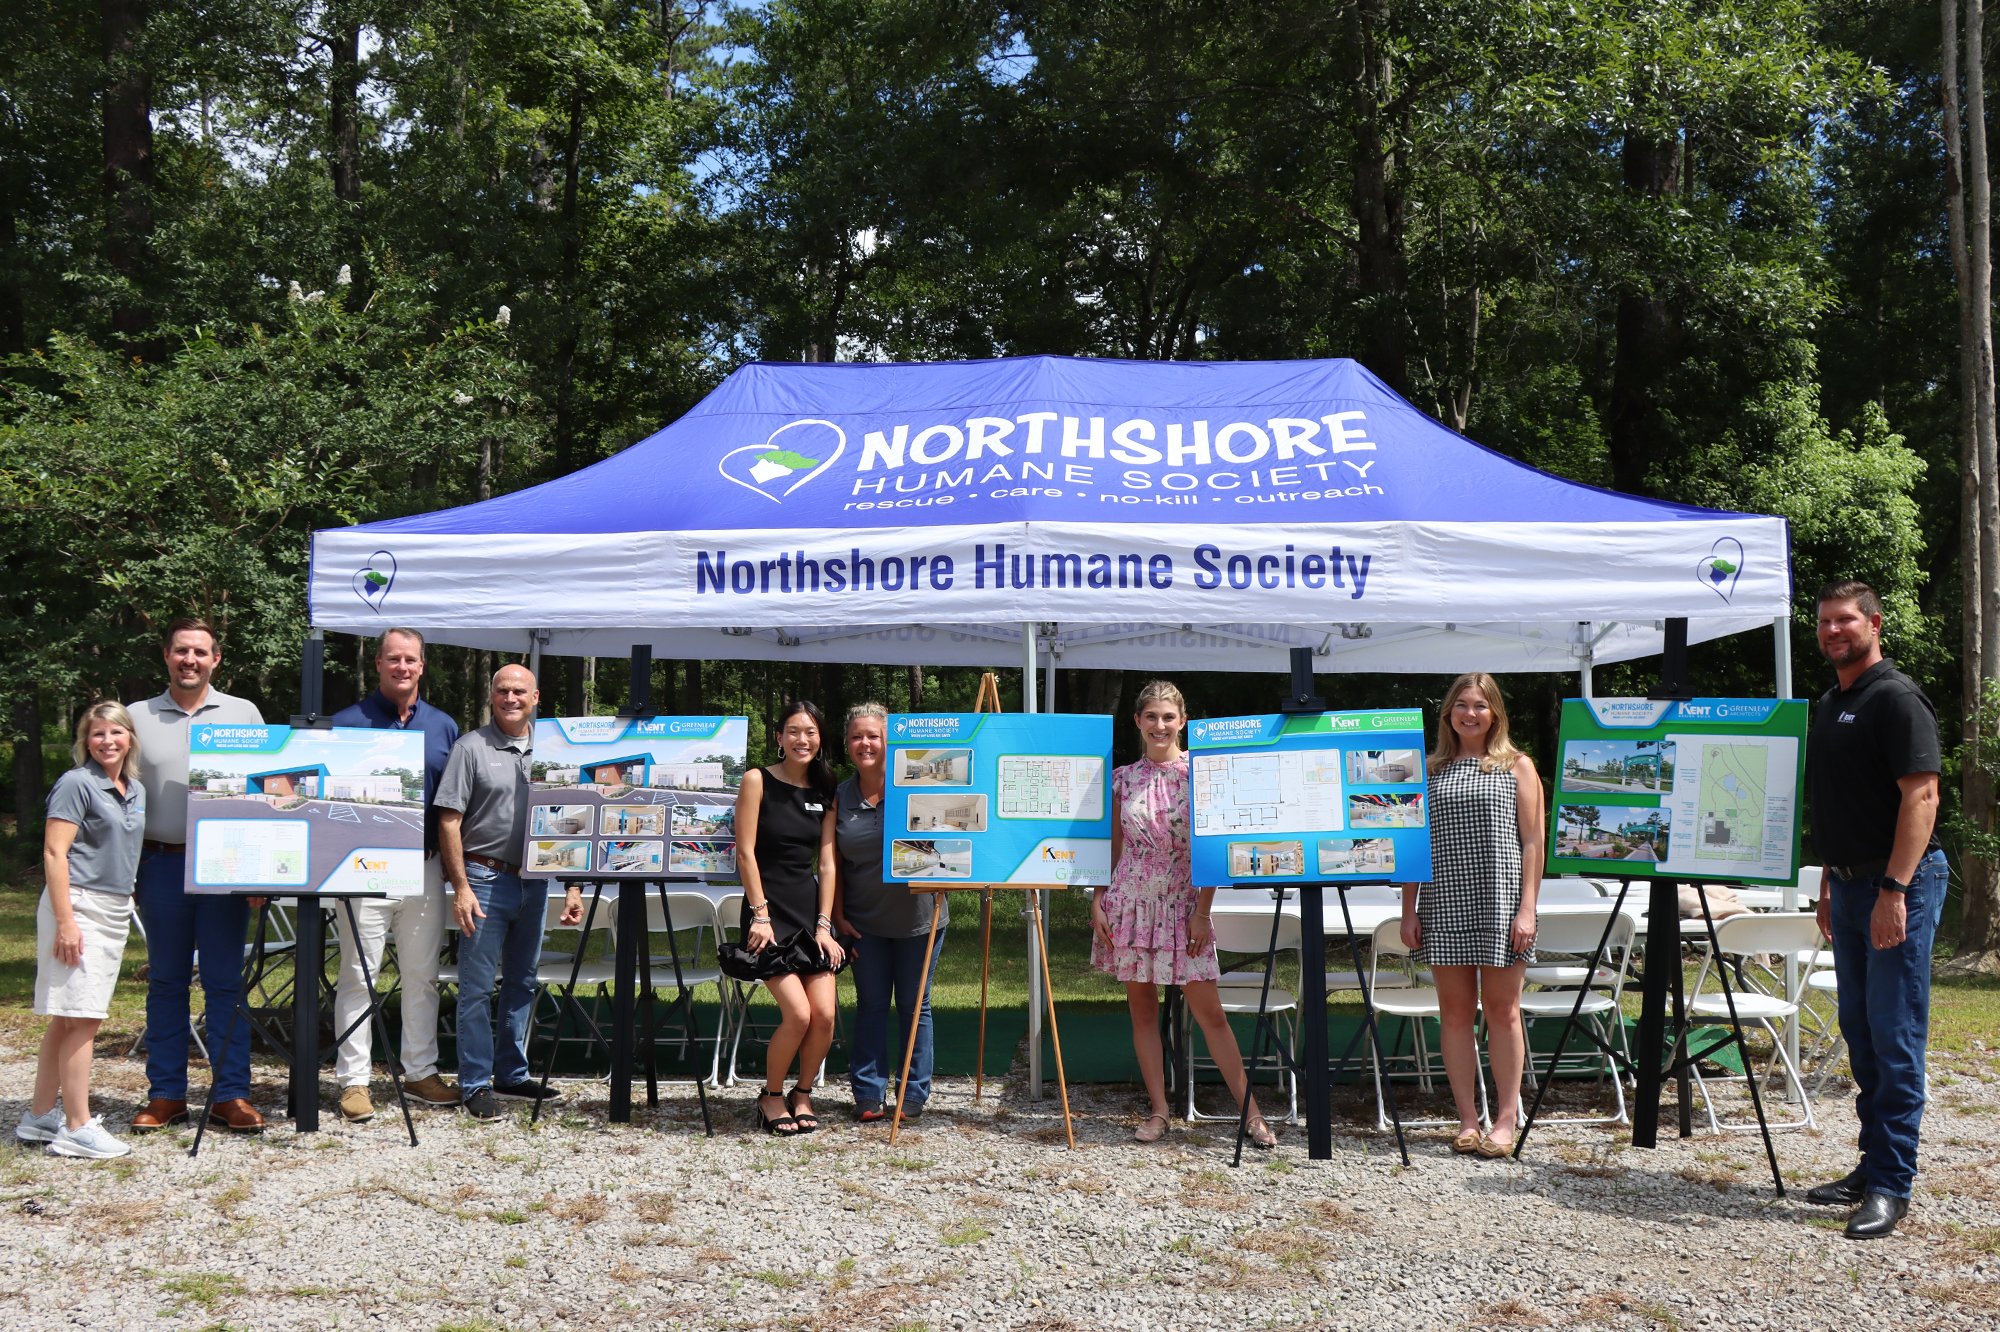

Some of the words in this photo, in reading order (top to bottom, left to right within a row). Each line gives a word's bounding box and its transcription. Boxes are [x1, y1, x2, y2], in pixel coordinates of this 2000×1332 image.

[857, 411, 1377, 471] NORTHSHORE
[852, 461, 1094, 496] HUMANE
[1121, 460, 1376, 491] SOCIETY
[843, 495, 955, 511] rescue
[990, 486, 1063, 498] care
[1100, 493, 1198, 505] no-kill
[1234, 483, 1384, 504] outreach
[697, 548, 954, 594] Northshore
[975, 544, 1173, 589] Humane
[1193, 543, 1372, 599] Society
[1611, 703, 1654, 711] NORTHSHORE
[1678, 702, 1712, 715] KENT
[637, 720, 666, 732] KENT
[908, 717, 960, 728] NORTHSHORE
[1208, 719, 1262, 731] NORTHSHORE
[1331, 716, 1361, 728] KENT
[214, 728, 269, 739] NORTHSHORE
[1042, 846, 1076, 860] KENT
[354, 856, 389, 870] KENT
